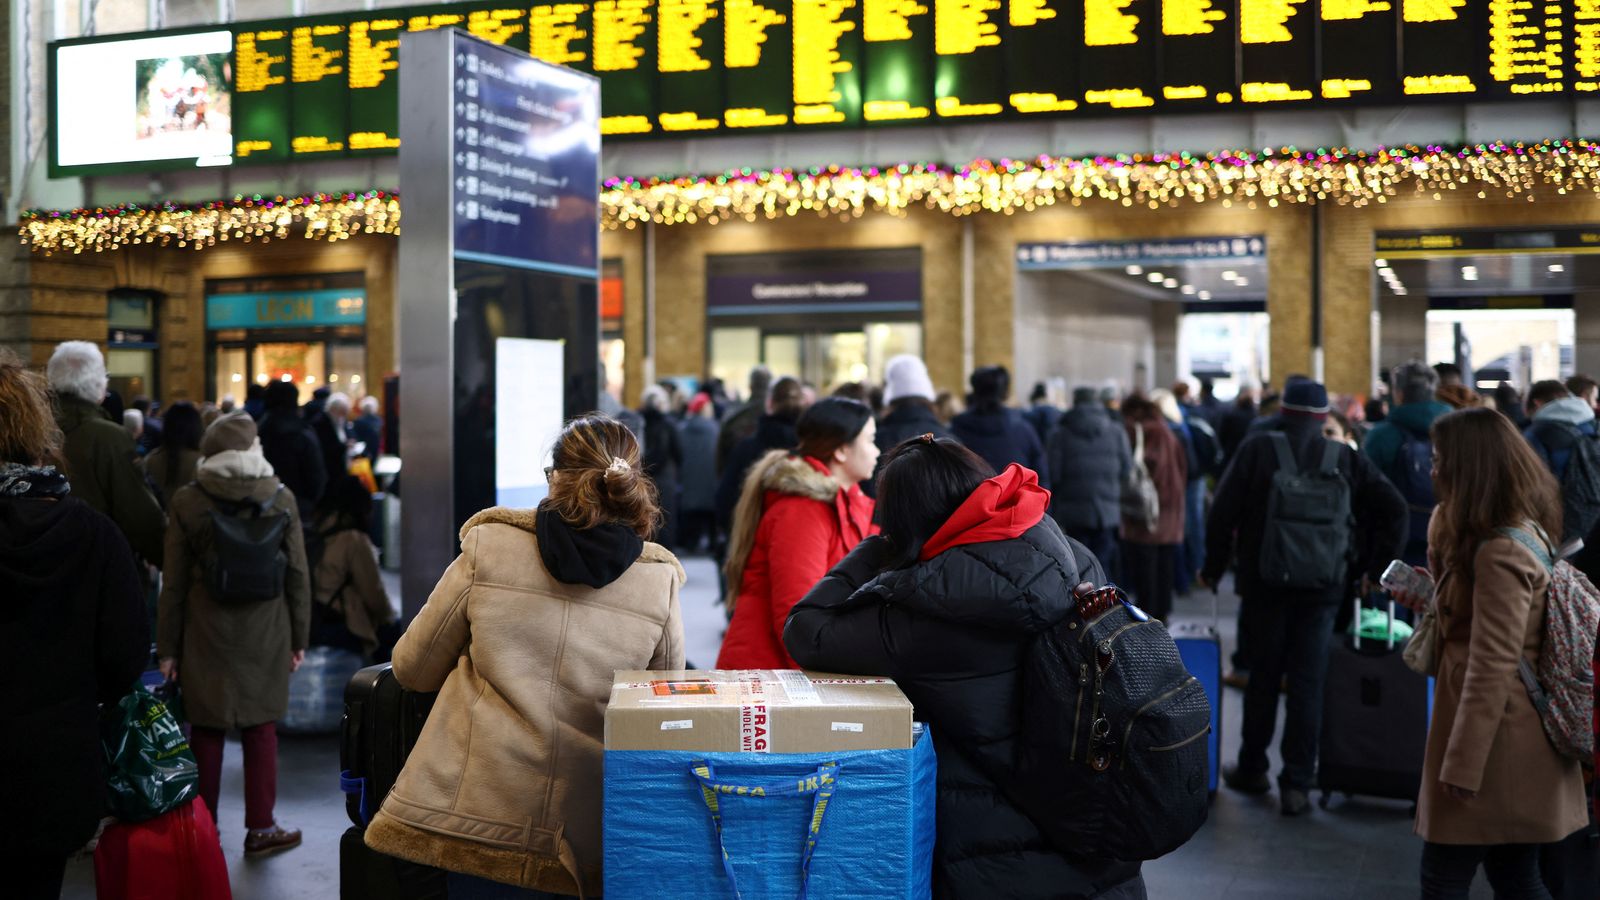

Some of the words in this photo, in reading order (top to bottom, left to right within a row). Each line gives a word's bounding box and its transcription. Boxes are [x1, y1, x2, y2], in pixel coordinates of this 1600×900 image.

[742, 705, 752, 734] ANDLE
[742, 735, 752, 752] WIT
[713, 784, 766, 797] IKEA
[798, 773, 831, 792] IKE
